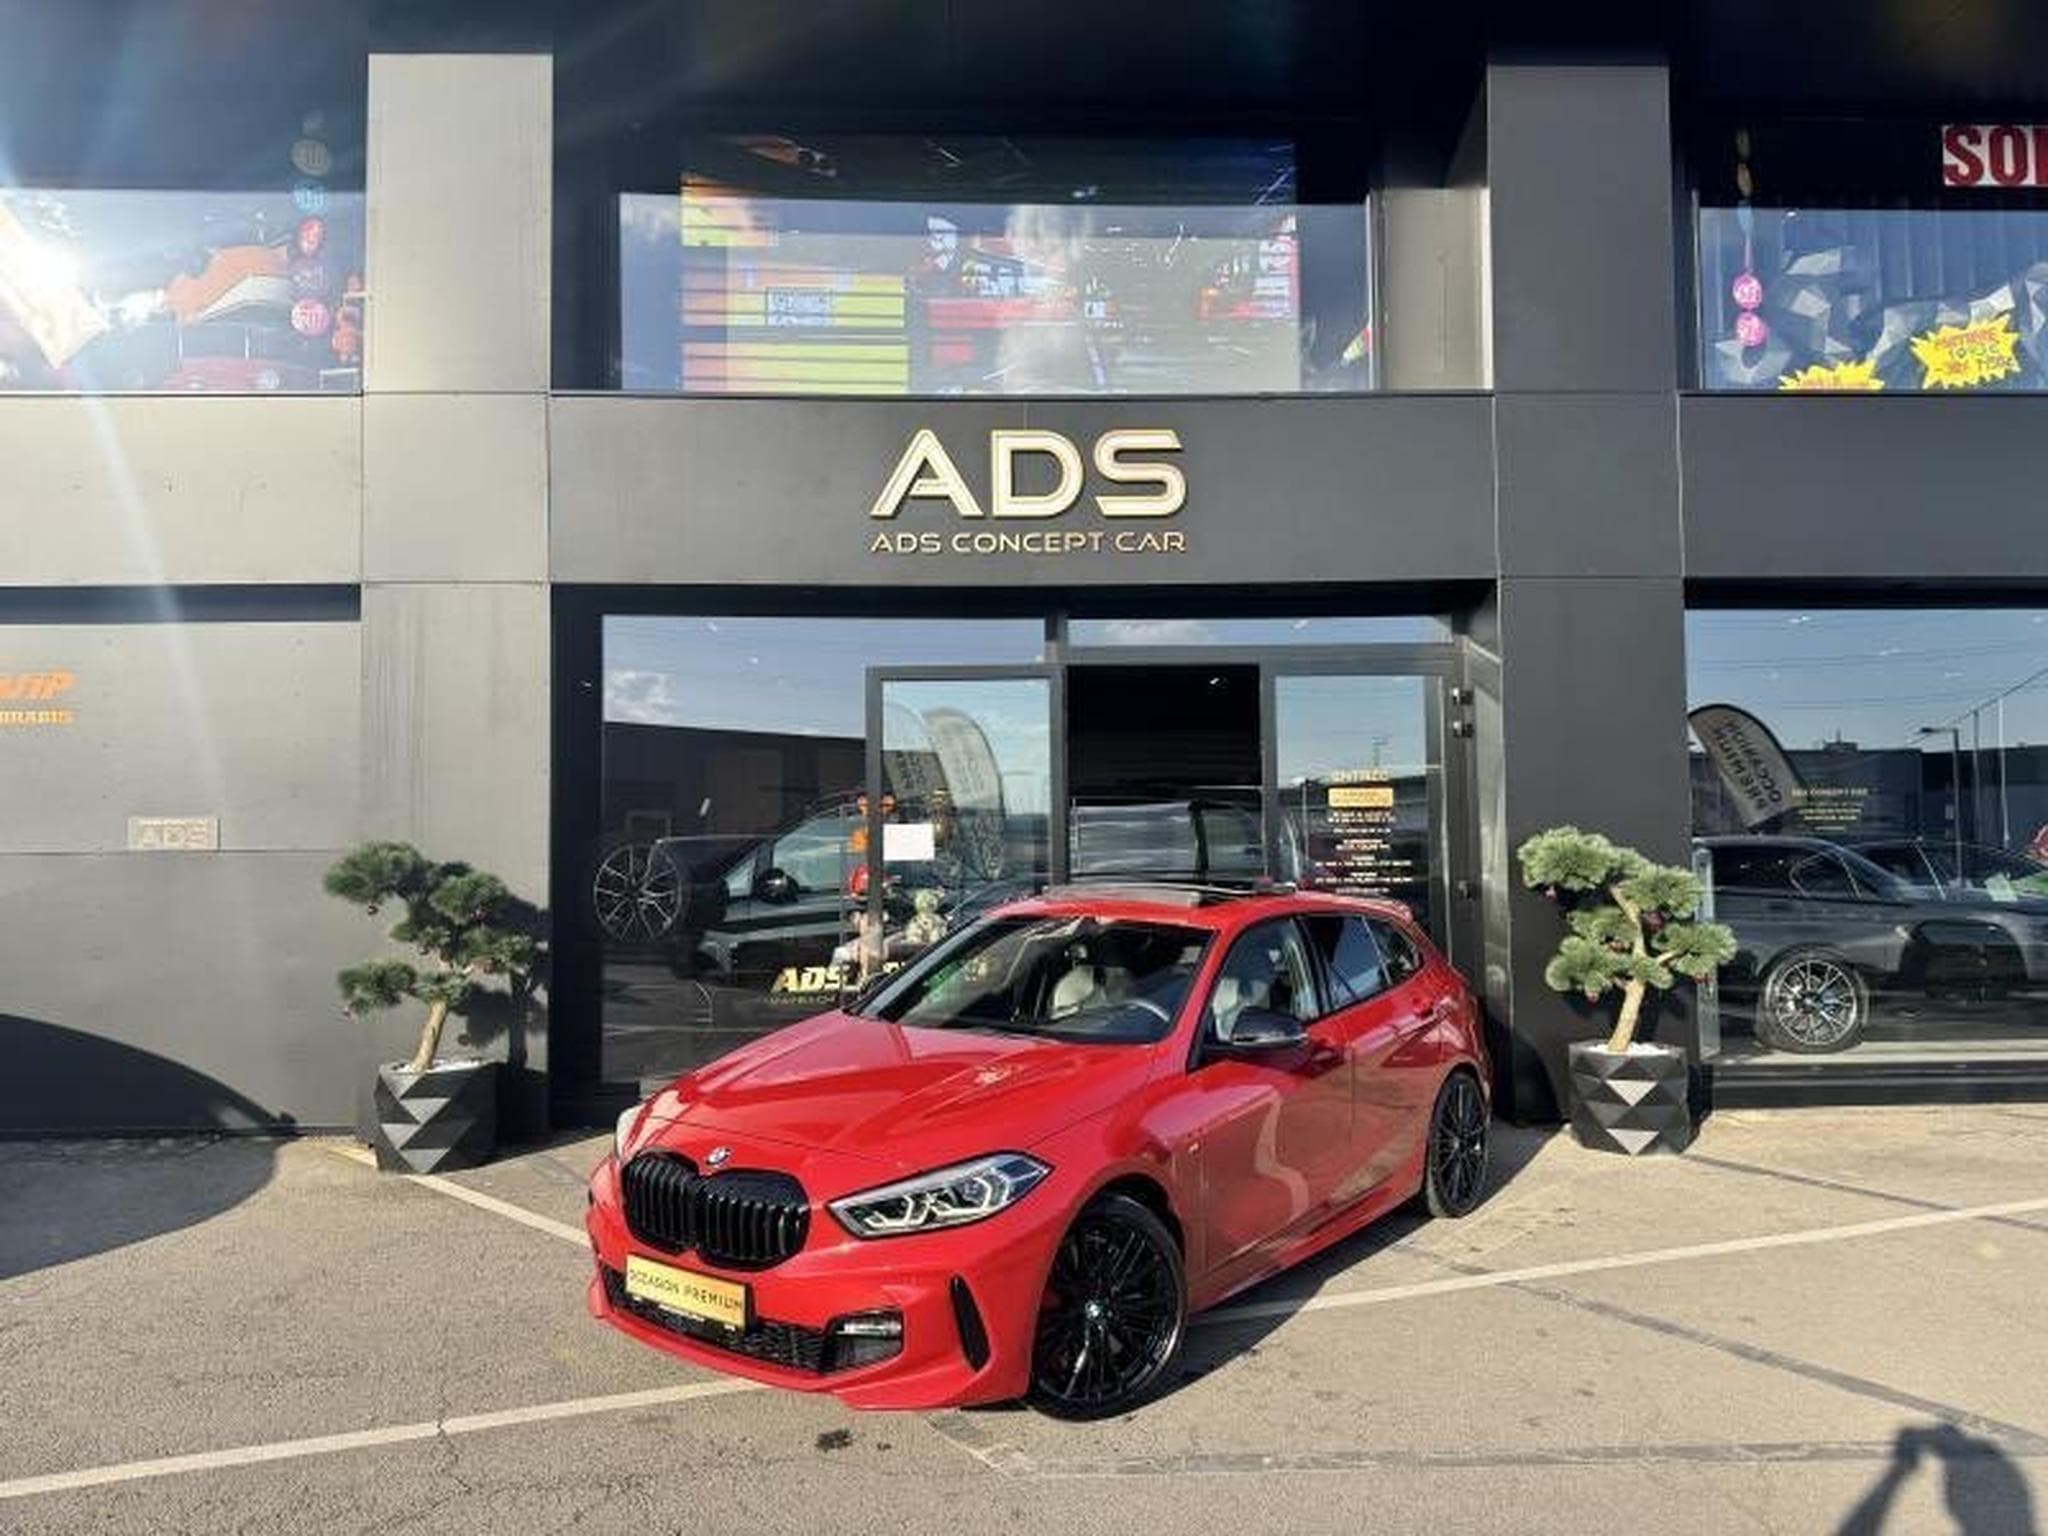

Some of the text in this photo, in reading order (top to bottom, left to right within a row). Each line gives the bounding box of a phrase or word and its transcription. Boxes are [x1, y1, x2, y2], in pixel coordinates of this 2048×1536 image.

[870, 429, 1186, 517] ADS
[870, 532, 1186, 552] ADS CONCEPT CAR
[683, 1283, 743, 1310] PREMIUM
